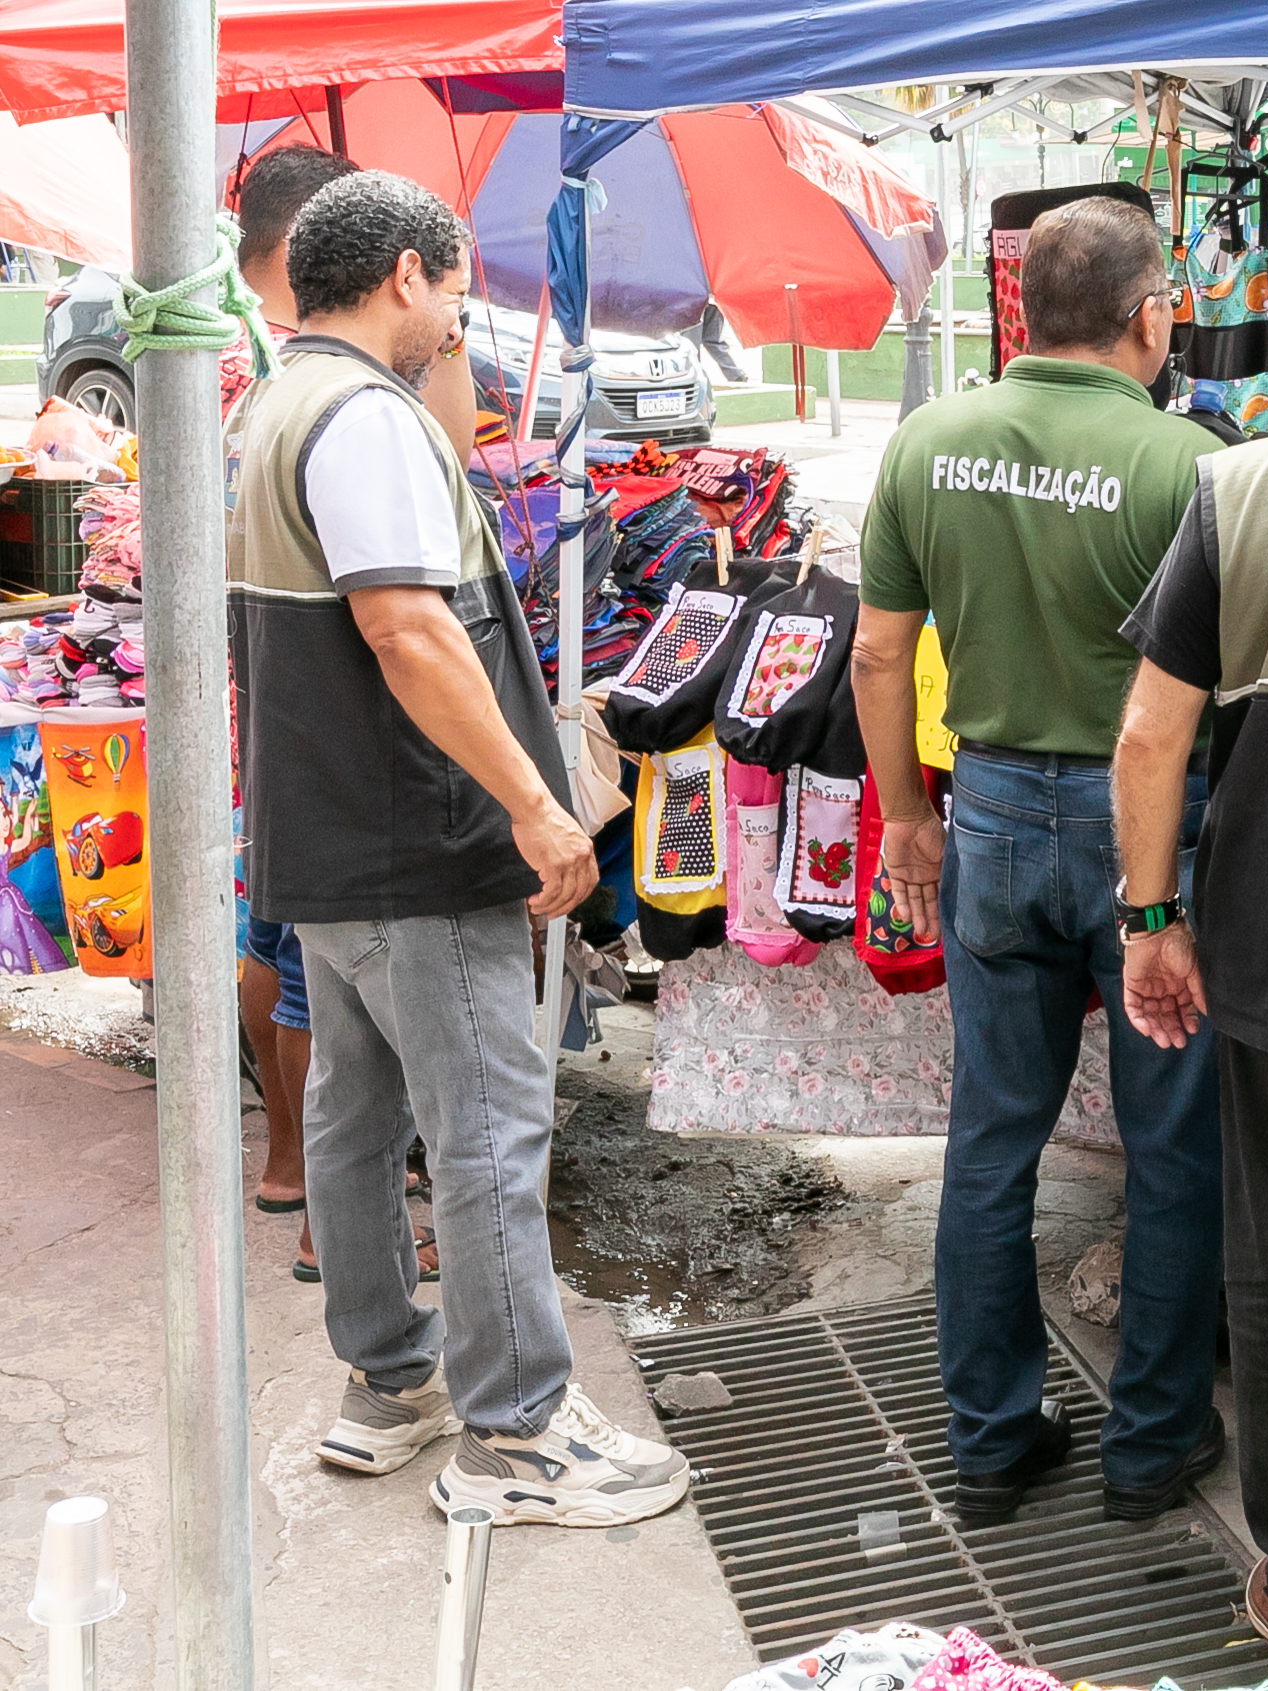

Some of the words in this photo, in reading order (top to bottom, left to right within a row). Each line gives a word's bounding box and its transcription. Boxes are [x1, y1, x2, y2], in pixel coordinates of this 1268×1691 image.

[932, 455, 1121, 514] FISCALIZAÇÃO
[786, 619, 811, 633] Saco
[674, 762, 702, 778] Saco
[825, 785, 851, 800] Saco
[745, 819, 770, 833] Saco
